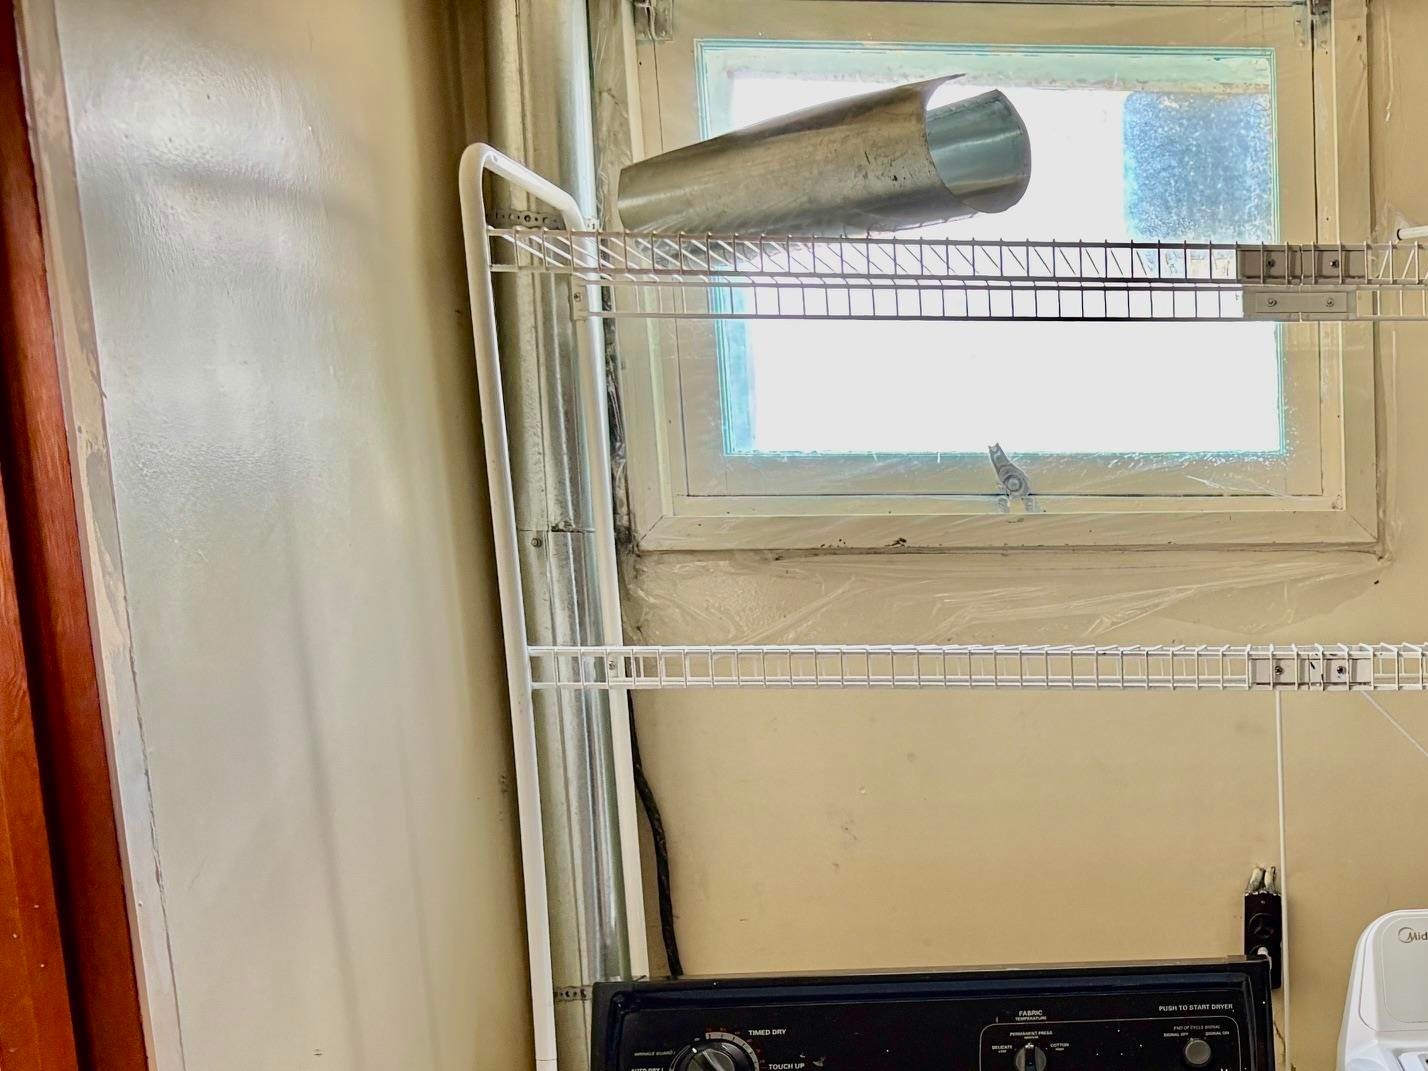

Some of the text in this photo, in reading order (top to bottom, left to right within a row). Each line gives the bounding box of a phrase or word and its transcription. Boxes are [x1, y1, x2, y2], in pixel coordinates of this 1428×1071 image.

[772, 1028, 787, 1036] DRY
[769, 1062, 806, 1071] TOUCH UP
